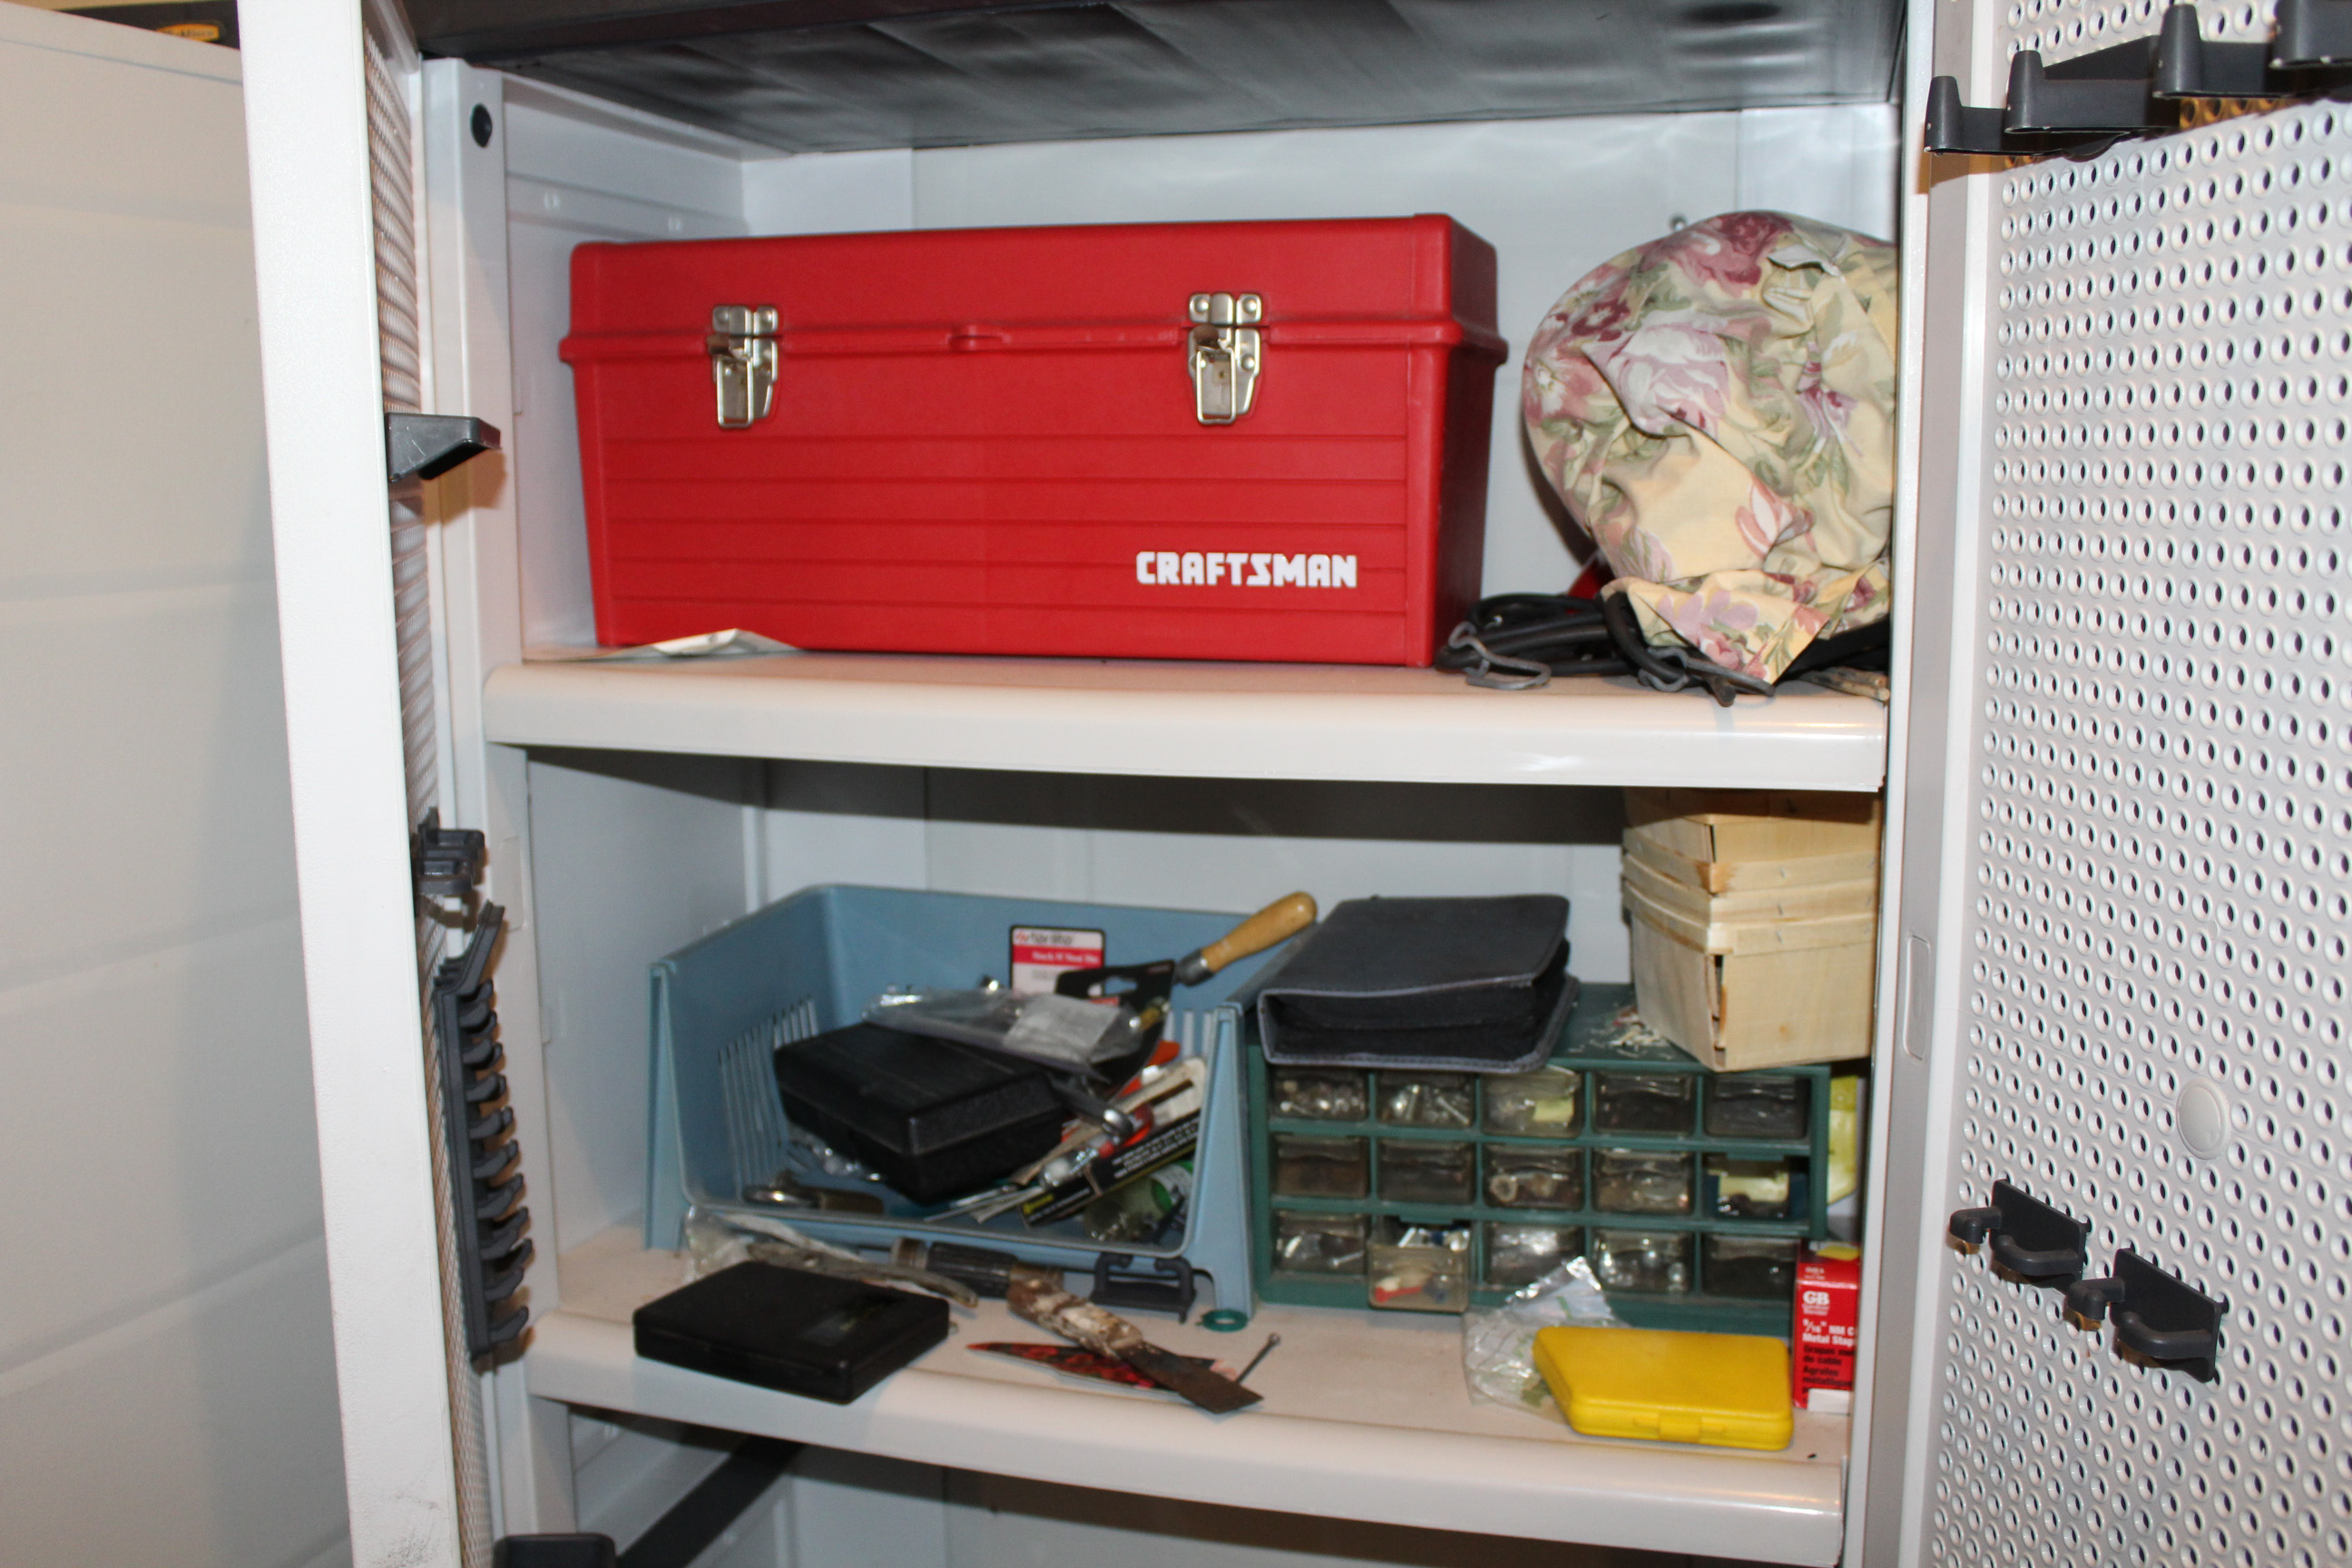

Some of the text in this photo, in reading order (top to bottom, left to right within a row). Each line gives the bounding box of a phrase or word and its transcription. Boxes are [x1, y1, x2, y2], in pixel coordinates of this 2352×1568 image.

[1136, 551, 1357, 588] CRAFTSMAN
[1802, 1290, 1830, 1306] GB
[1802, 1331, 1830, 1344] Metal
